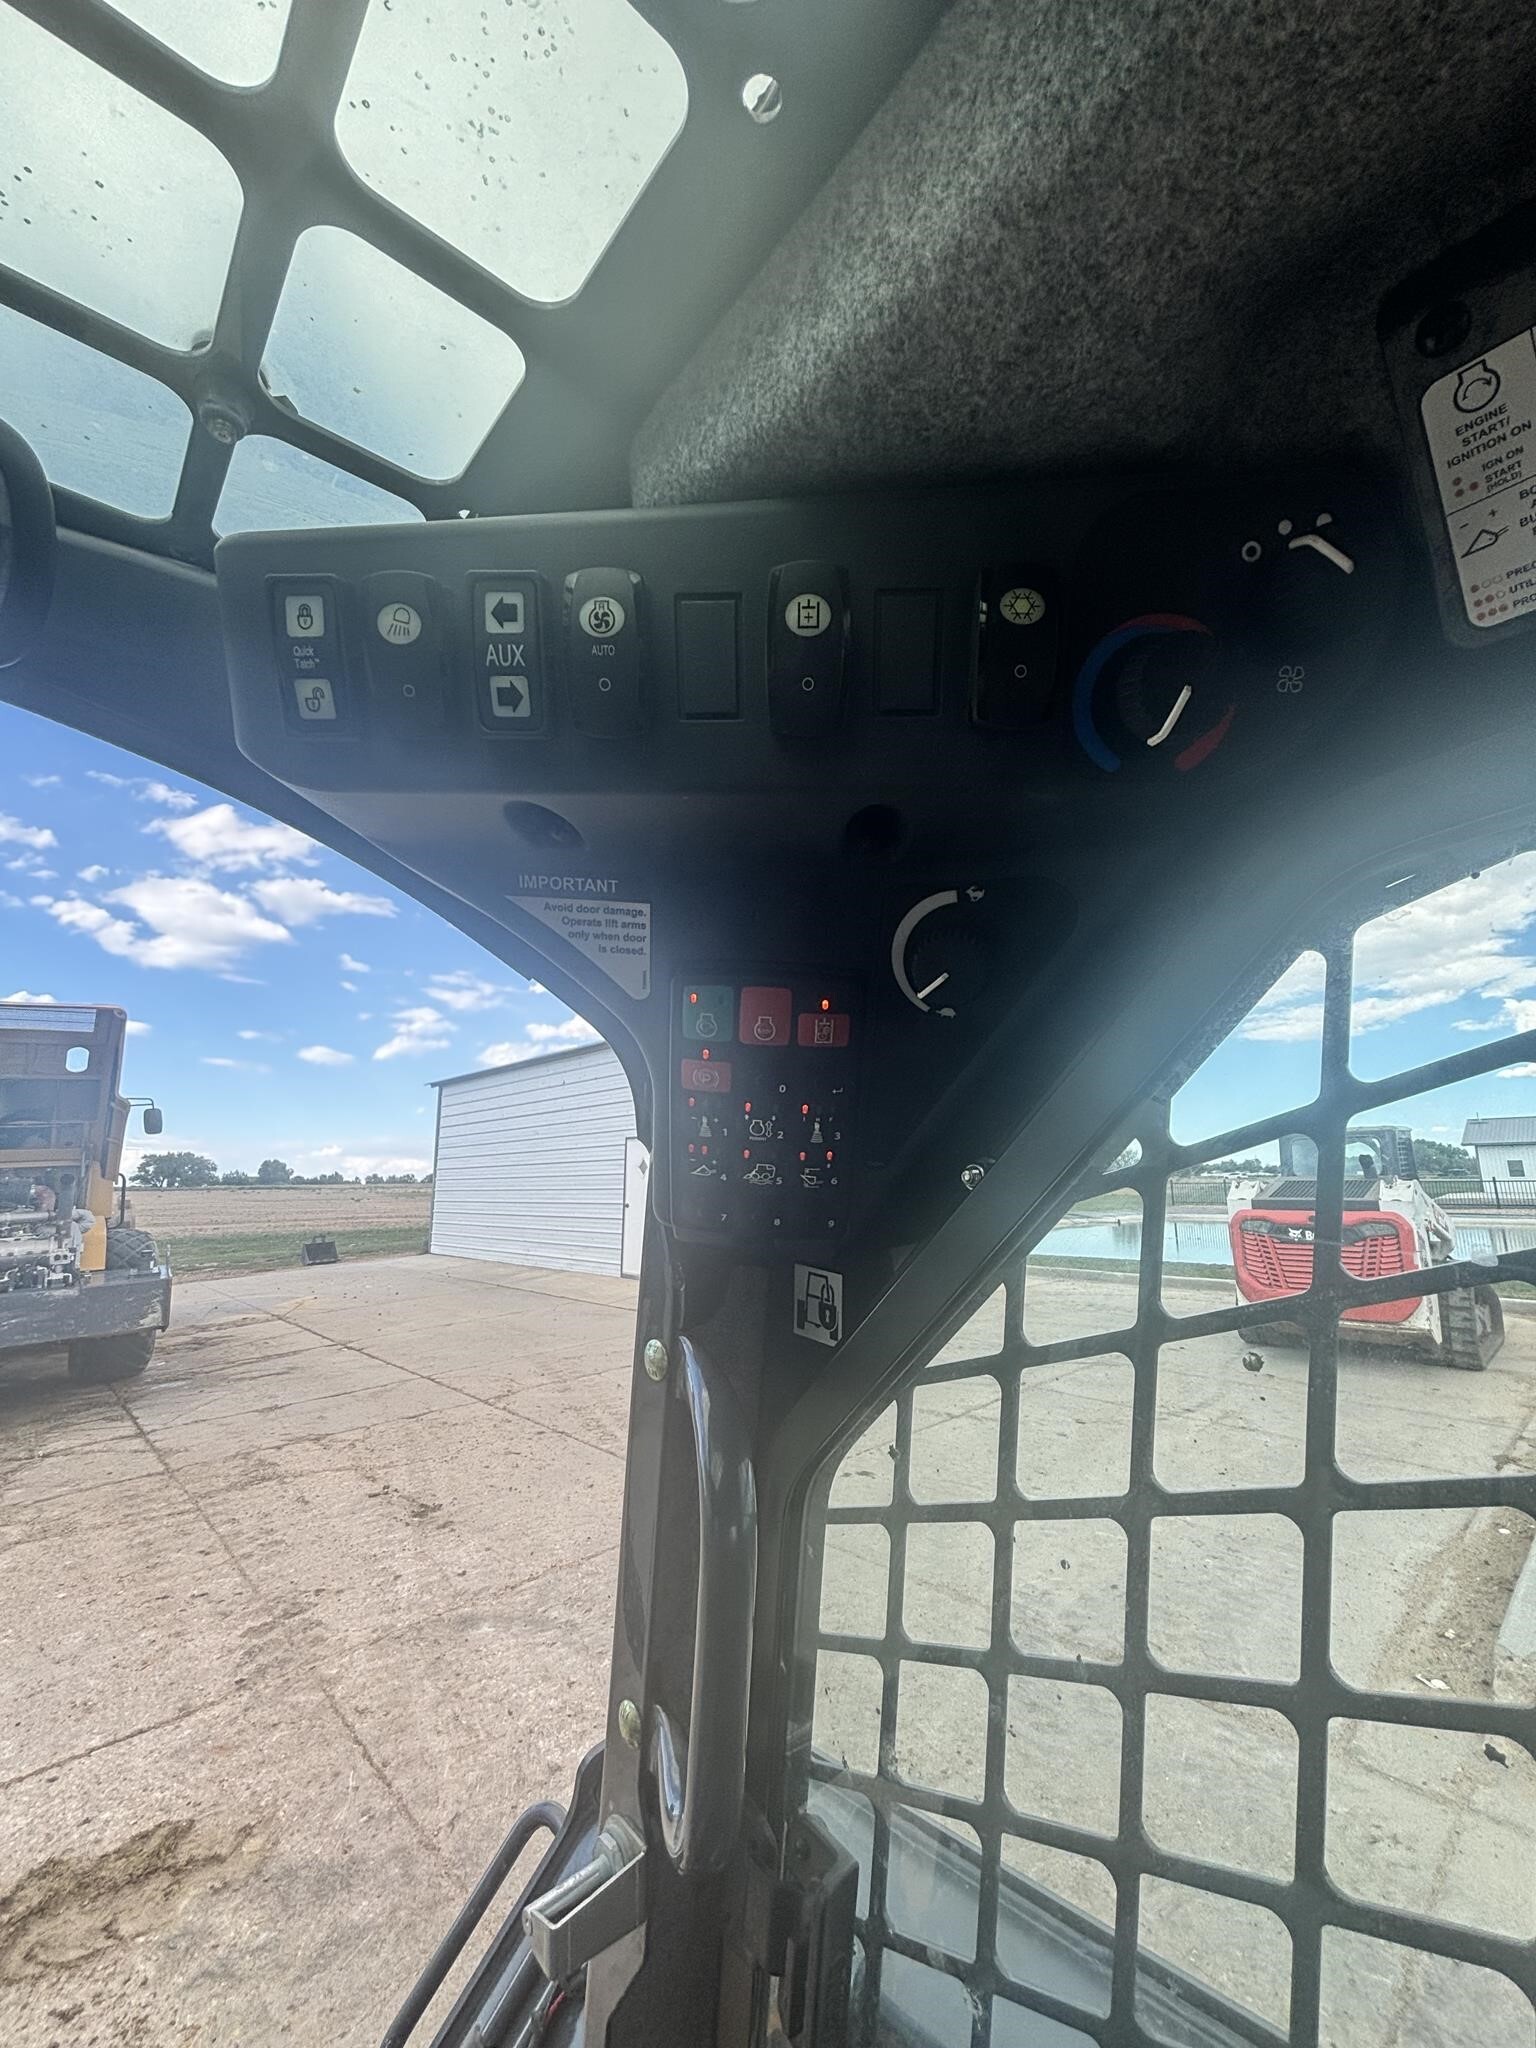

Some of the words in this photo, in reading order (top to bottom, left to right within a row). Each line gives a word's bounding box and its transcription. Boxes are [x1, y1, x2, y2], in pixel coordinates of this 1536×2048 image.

[1455, 402, 1509, 437] ENGINE
[1462, 415, 1511, 447] START/
[1446, 432, 1507, 469] IGNITION
[1510, 419, 1532, 437] ON
[1481, 456, 1503, 472] IGN
[1506, 445, 1524, 459] ON
[1484, 459, 1522, 483] START
[1487, 470, 1522, 493] (HOLD)
[486, 643, 525, 667] AUX
[592, 645, 615, 656] AUTO
[519, 875, 619, 893] IMPORTANT
[543, 902, 573, 913] Avoid
[576, 903, 600, 914] door
[603, 906, 647, 918] damage.
[561, 916, 602, 928] Operate
[605, 918, 618, 929] lift
[621, 922, 647, 930] arms
[568, 930, 590, 941] only
[592, 932, 620, 942] when
[623, 933, 647, 943] door
[610, 945, 647, 955] closed.
[722, 1127, 728, 1136] 1
[776, 1131, 784, 1140] 2
[834, 1131, 841, 1140] 3
[720, 1173, 727, 1181] 4
[776, 1177, 782, 1185] 5
[830, 1177, 838, 1185] 6
[721, 1213, 728, 1222] 7
[773, 1218, 781, 1226] 8
[828, 1219, 835, 1228] 9
